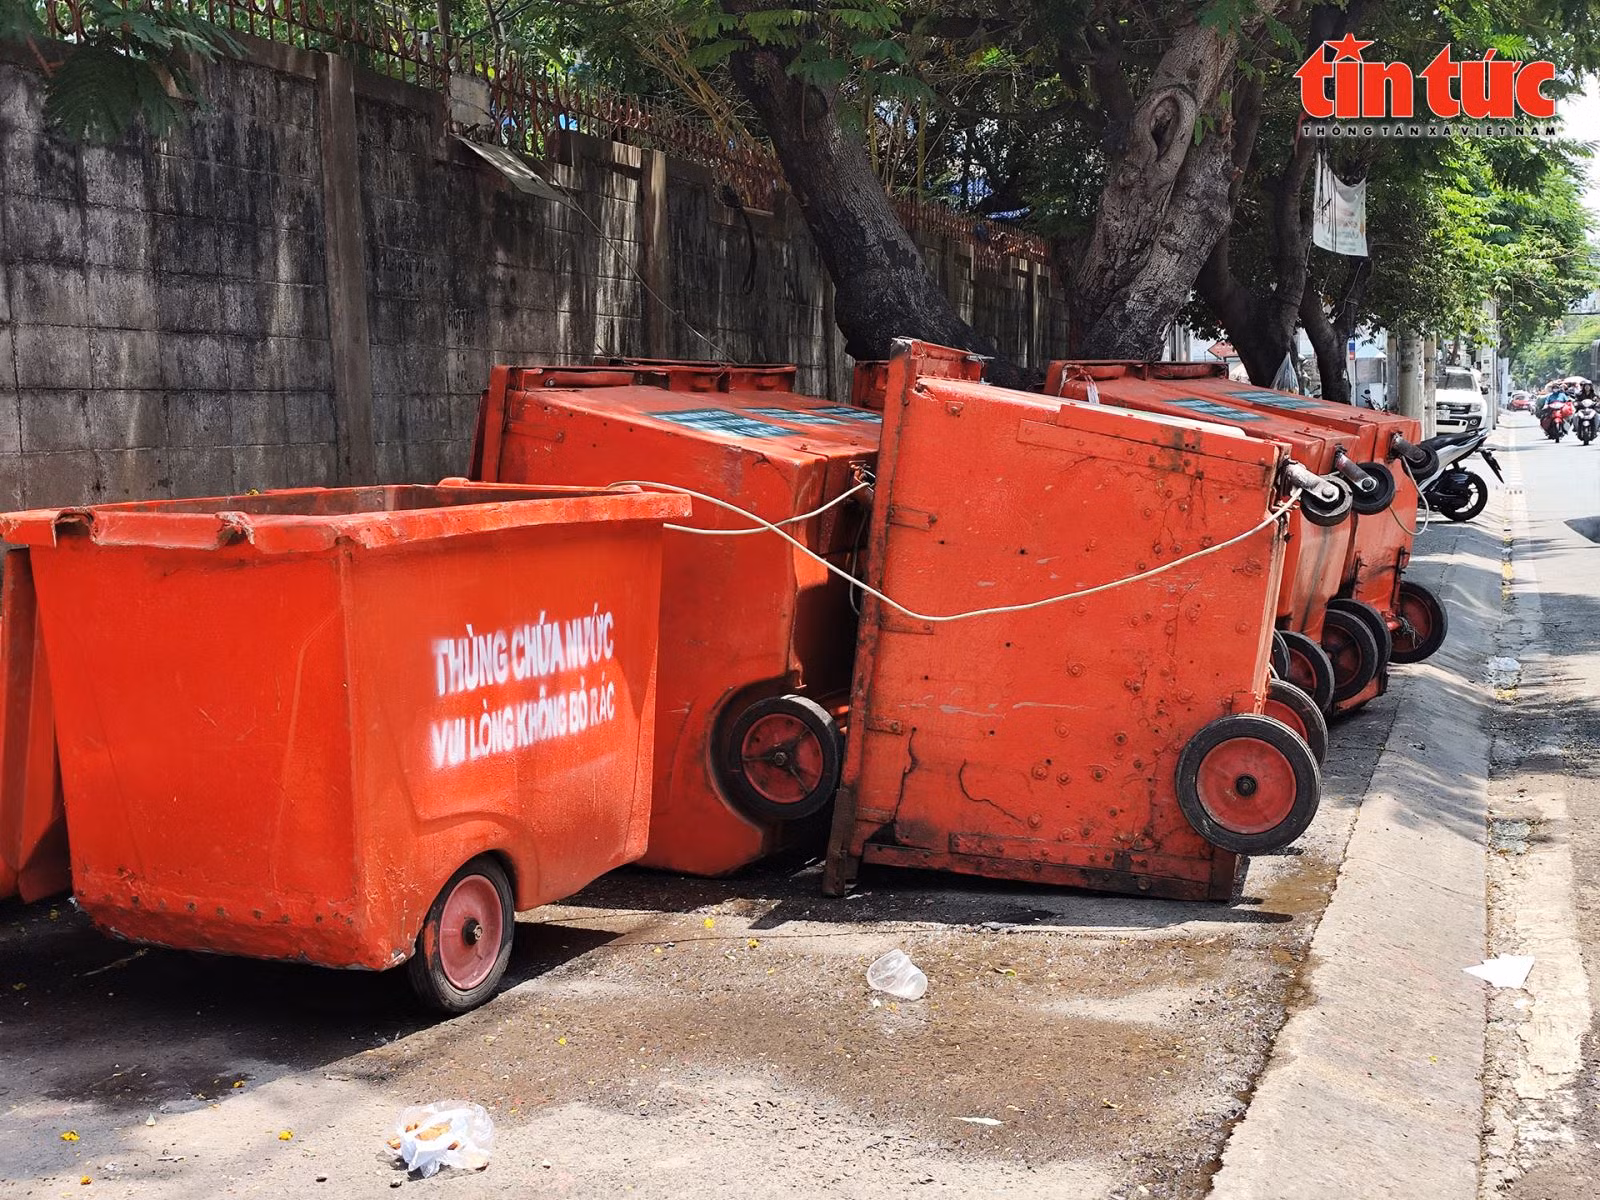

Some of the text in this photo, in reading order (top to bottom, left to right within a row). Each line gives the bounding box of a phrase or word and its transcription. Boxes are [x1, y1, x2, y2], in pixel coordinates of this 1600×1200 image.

[433, 603, 613, 697] THÙNG CHỨA NƯỚC
[431, 718, 466, 768] VUI
[469, 698, 514, 760] LÒNG
[516, 685, 567, 748] KHÔNG
[590, 672, 614, 726] RÁC
